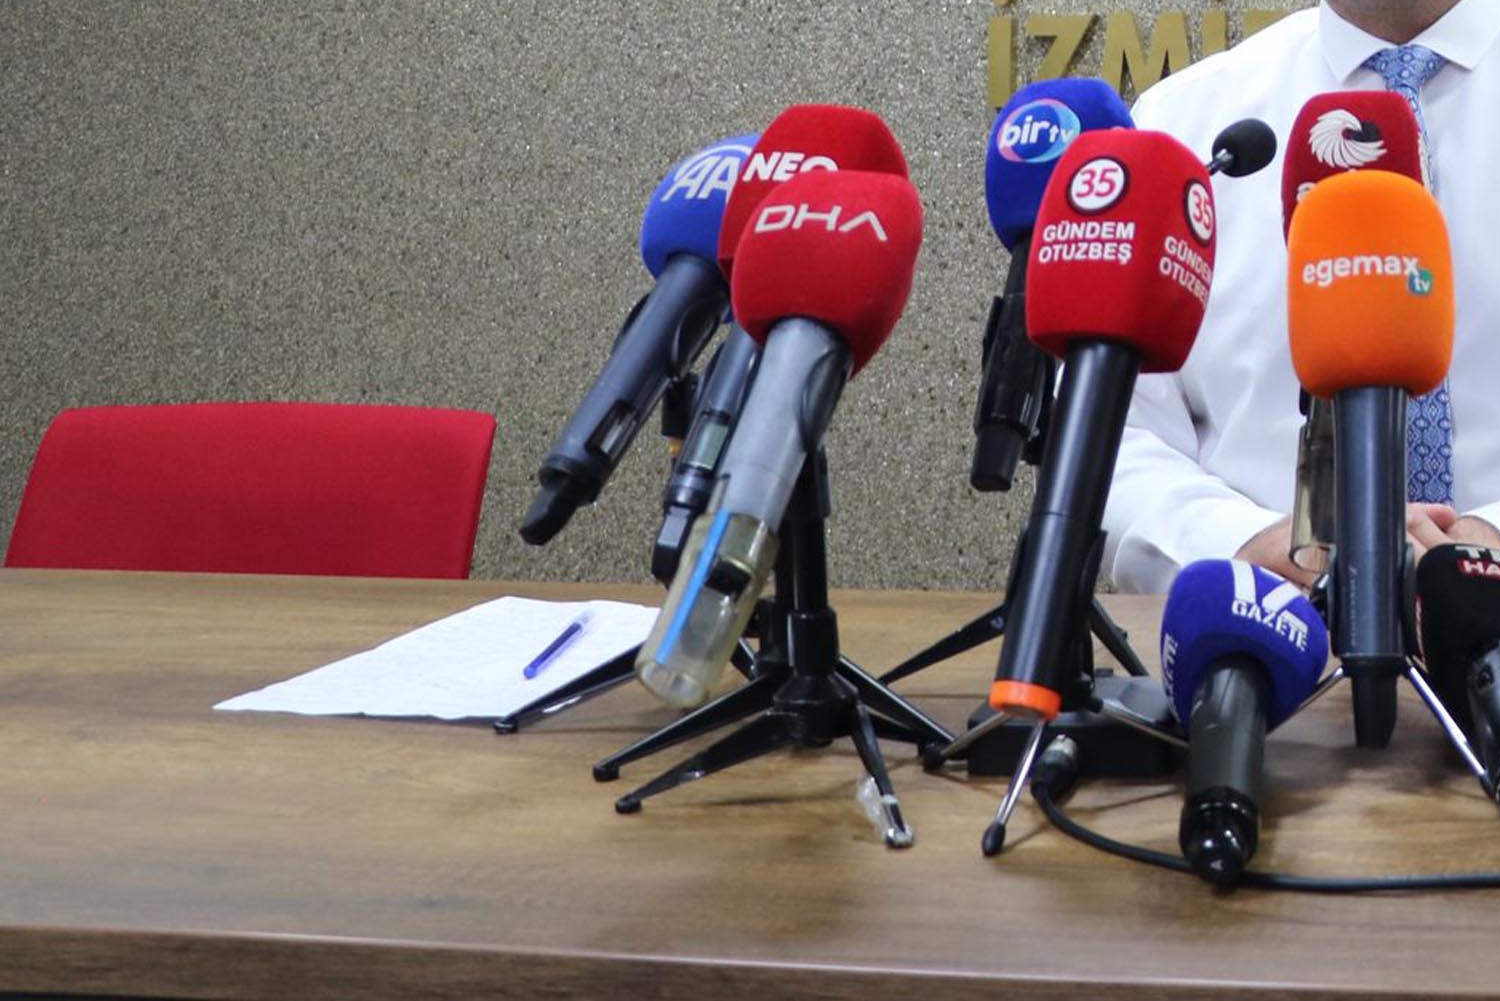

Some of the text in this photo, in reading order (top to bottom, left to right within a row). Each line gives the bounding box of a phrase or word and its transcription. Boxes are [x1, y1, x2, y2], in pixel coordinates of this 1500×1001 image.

[1076, 167, 1118, 198] 35
[755, 203, 887, 242] DHA
[1192, 189, 1214, 231] 35
[1043, 221, 1135, 242] GÜNDEM
[1038, 242, 1132, 265] OTUZBEŞ
[1303, 255, 1431, 293] egemax tv
[1231, 599, 1308, 652] GAZETE
